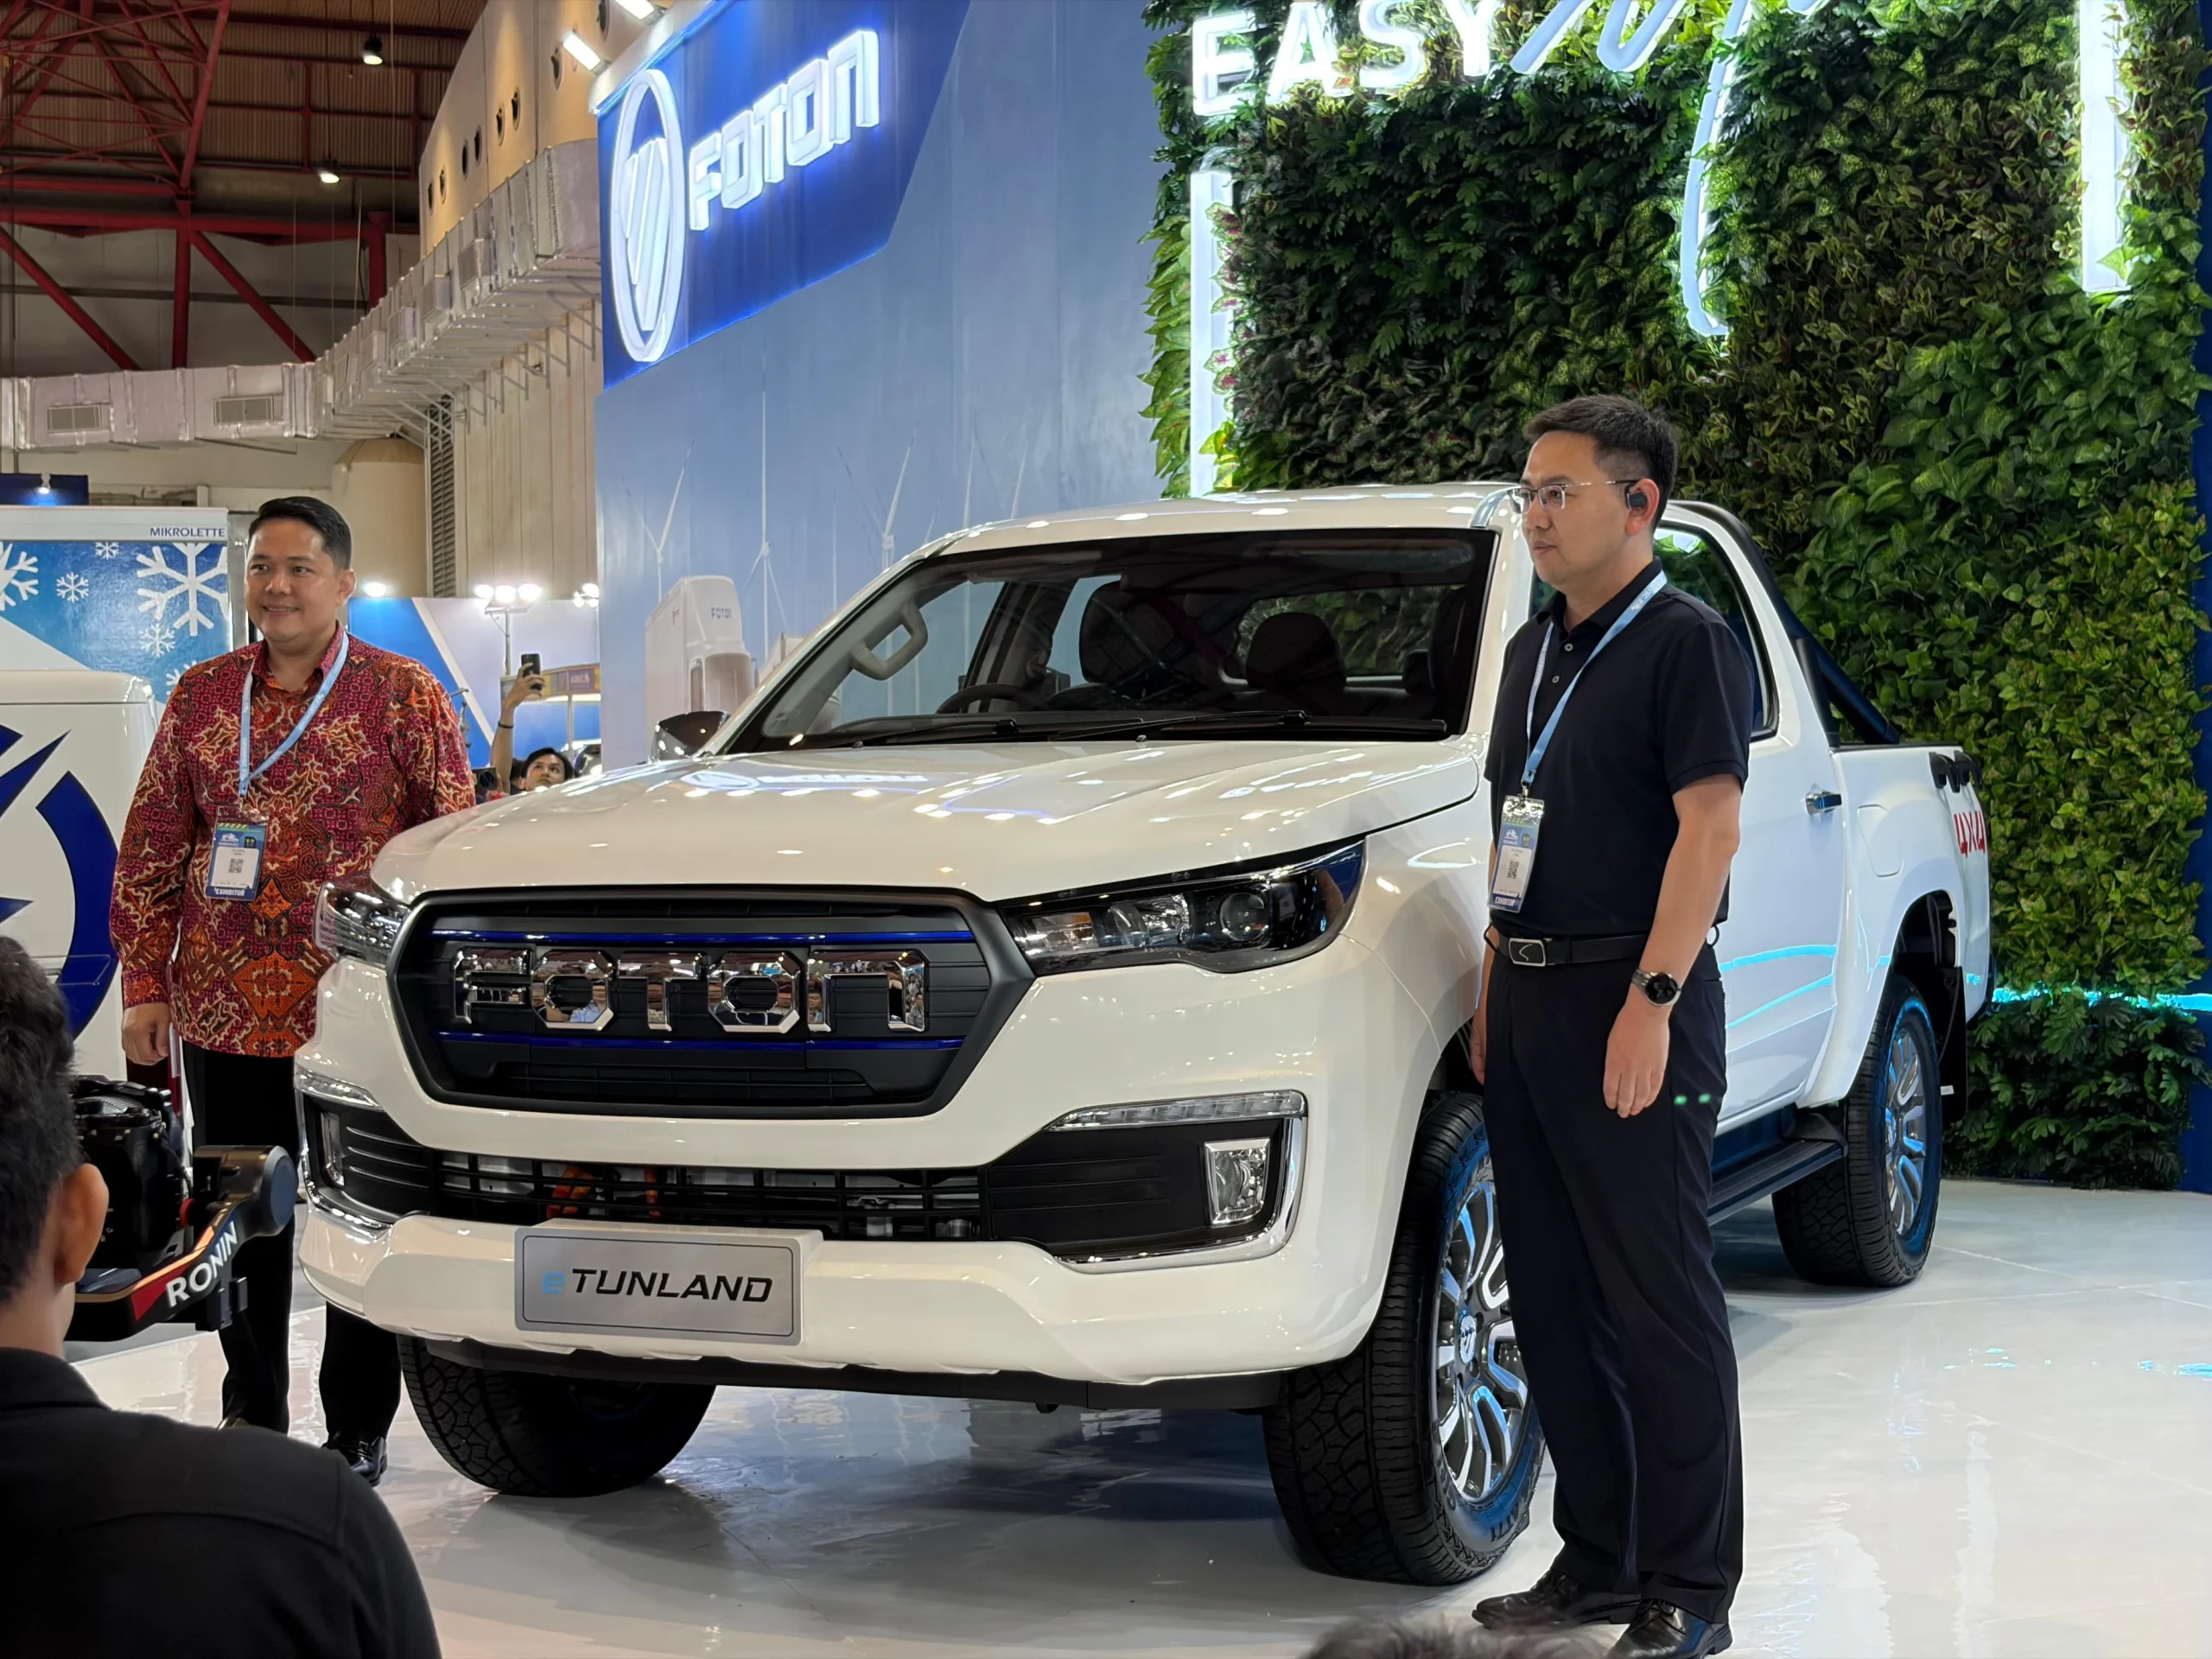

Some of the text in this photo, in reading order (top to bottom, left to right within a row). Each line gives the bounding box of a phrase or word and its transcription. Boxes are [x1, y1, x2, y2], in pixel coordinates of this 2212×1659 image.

[1192, 0, 1505, 117] EASY
[689, 29, 880, 231] FOTON
[149, 527, 226, 537] MIKROLETTE
[452, 948, 926, 1033] FOTON
[166, 1220, 238, 1308] RONIN
